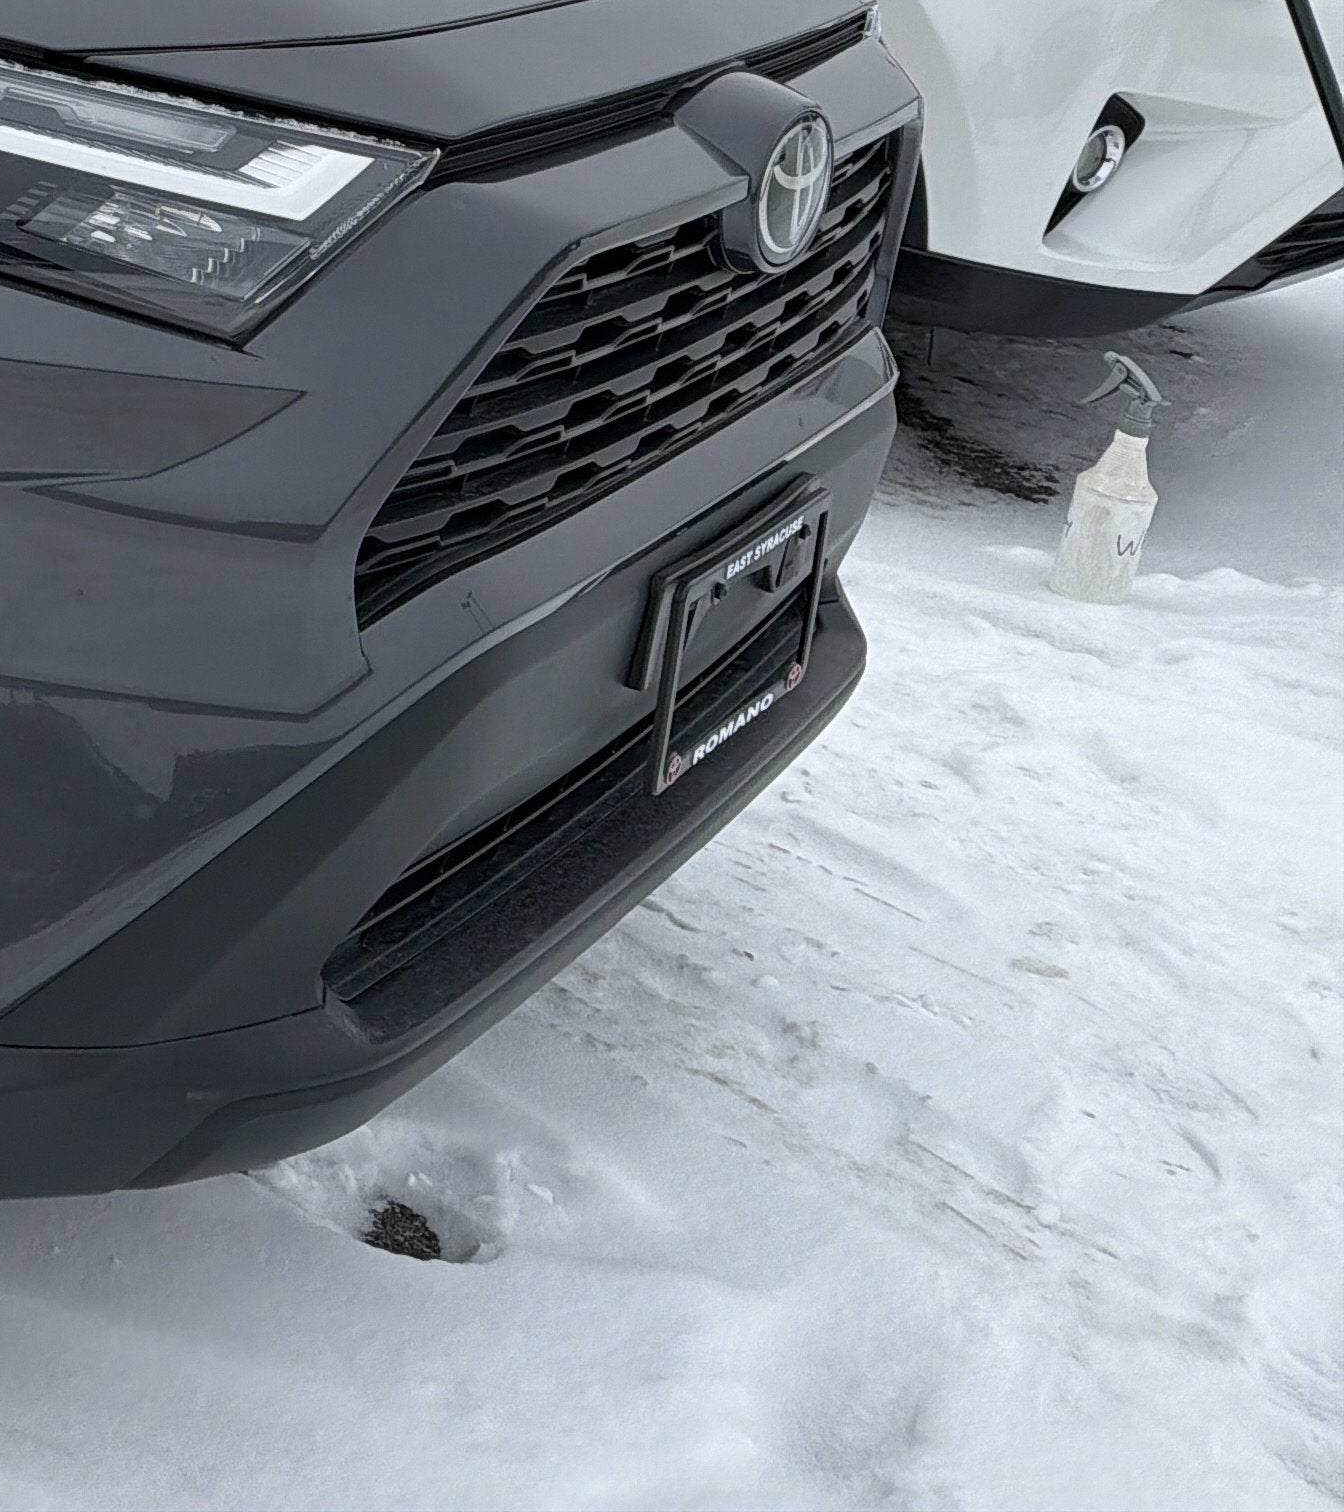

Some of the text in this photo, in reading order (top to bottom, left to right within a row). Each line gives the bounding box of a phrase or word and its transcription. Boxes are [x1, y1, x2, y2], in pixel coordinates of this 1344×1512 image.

[726, 515, 805, 580] EAST SYRACUSE
[692, 693, 774, 766] ROMANO
